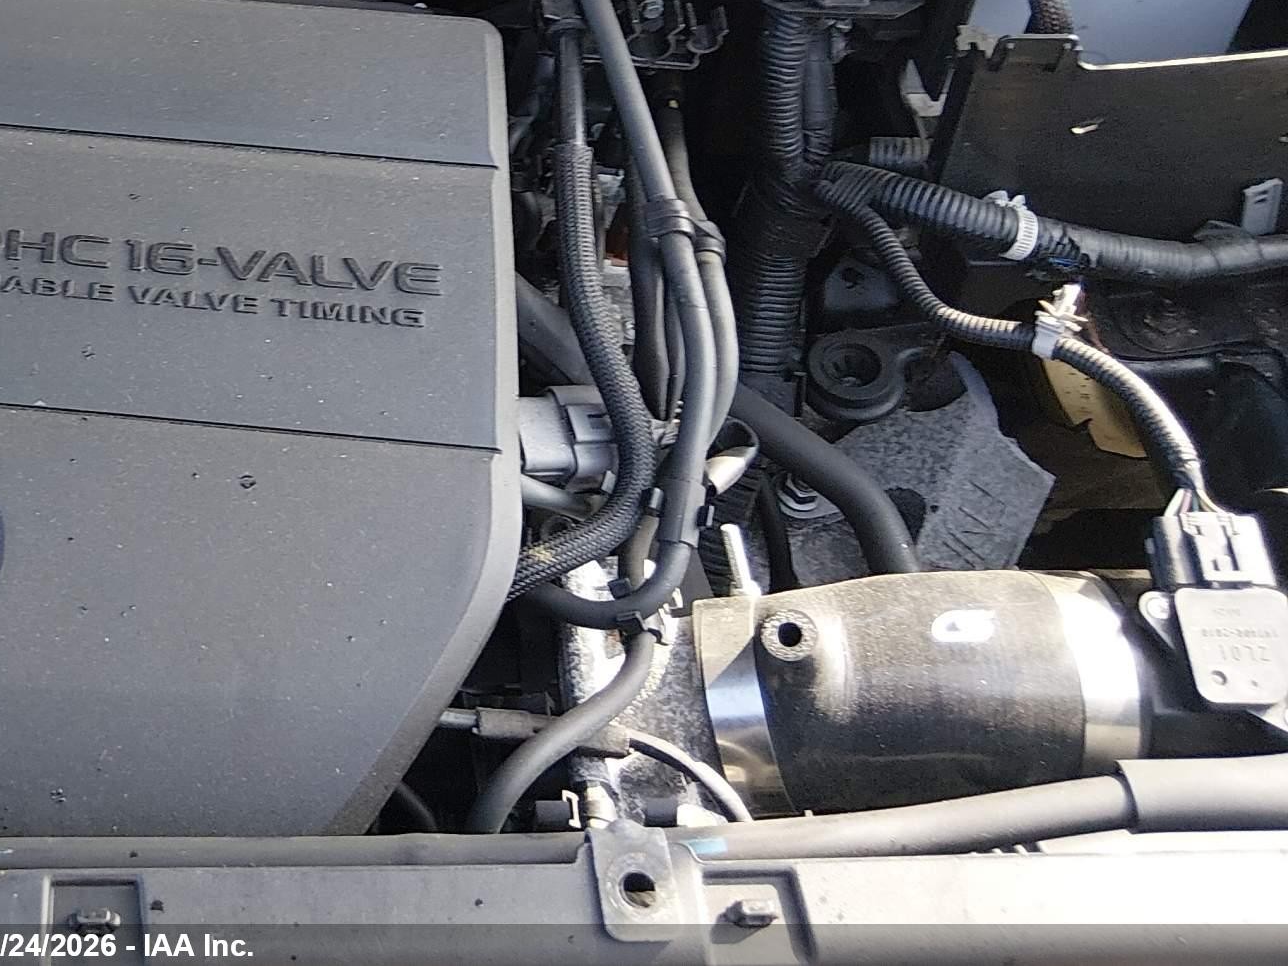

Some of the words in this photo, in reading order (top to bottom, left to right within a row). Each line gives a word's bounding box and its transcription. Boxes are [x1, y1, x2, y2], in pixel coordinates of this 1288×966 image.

[126, 238, 444, 297] 16-VALVE
[128, 284, 259, 315] VALVE
[271, 297, 426, 328] TIMING
